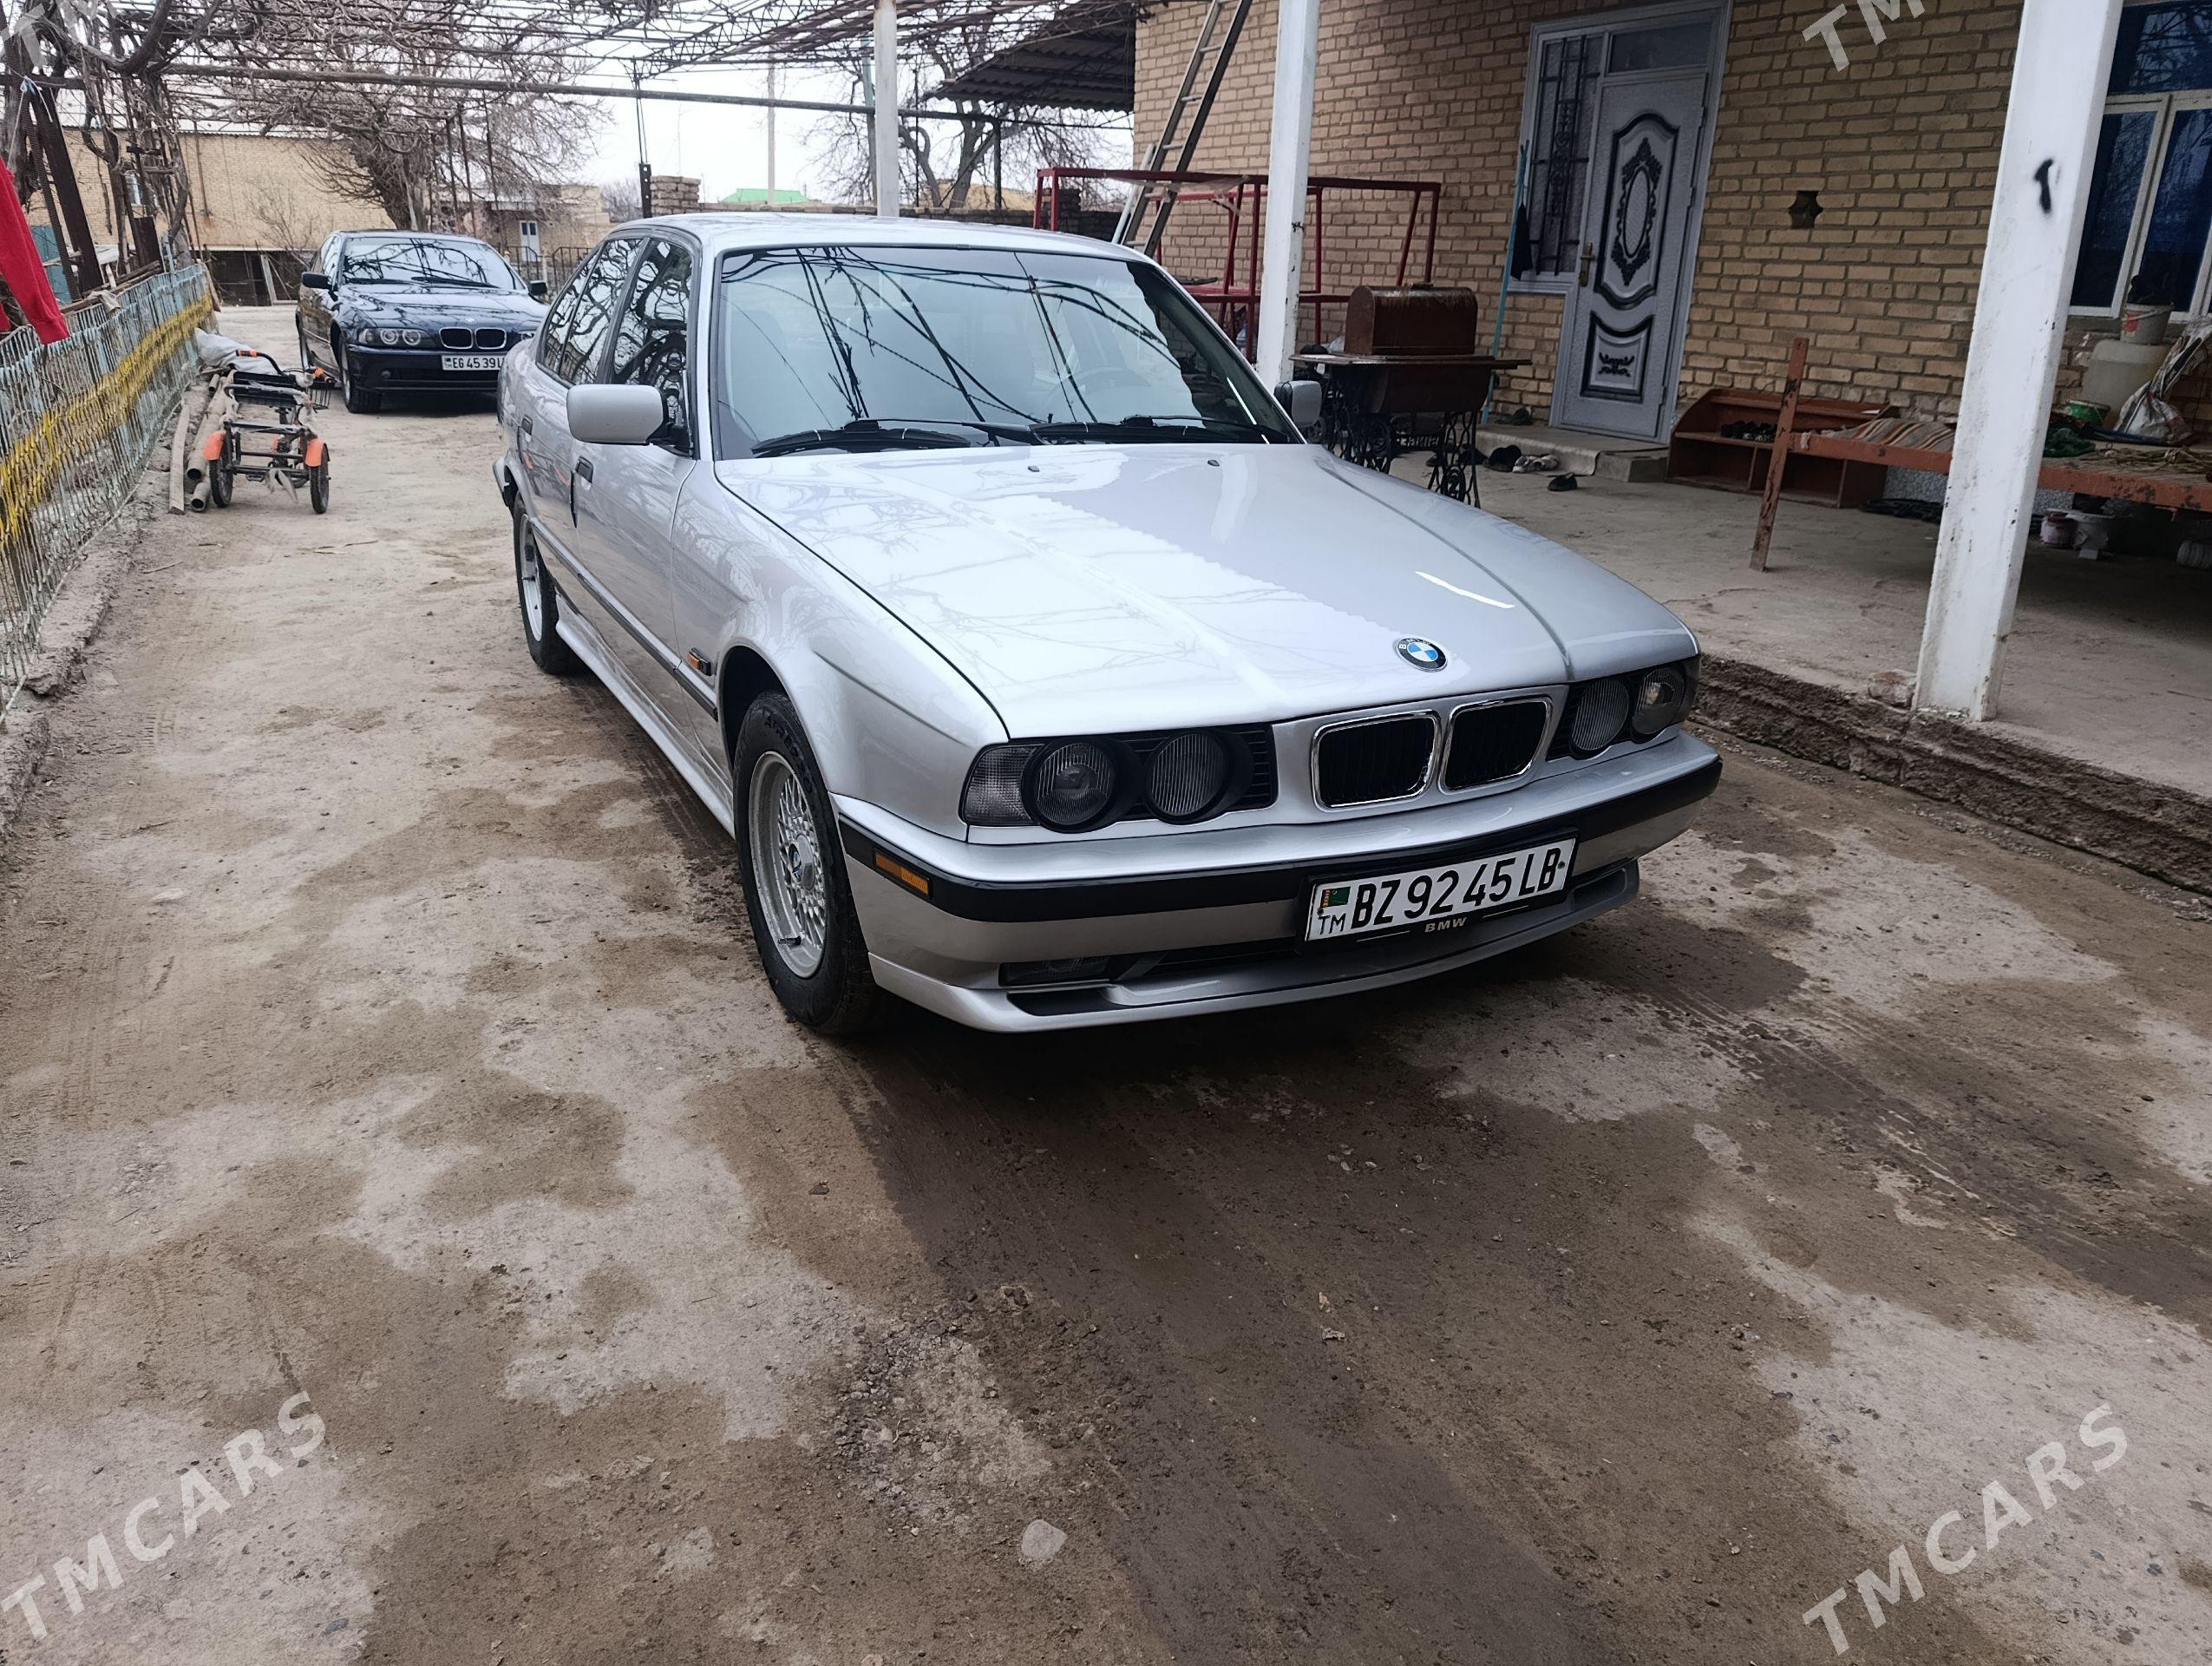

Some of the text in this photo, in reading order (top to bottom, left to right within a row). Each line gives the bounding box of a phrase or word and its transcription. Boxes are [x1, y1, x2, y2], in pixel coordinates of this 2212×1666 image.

[453, 357, 464, 369] EG
[467, 357, 481, 369] 45
[482, 357, 496, 369] 39
[1351, 847, 1561, 929] BZ 92 45 LB
[1318, 913, 1346, 935] TM
[1424, 916, 1467, 933] BMW
